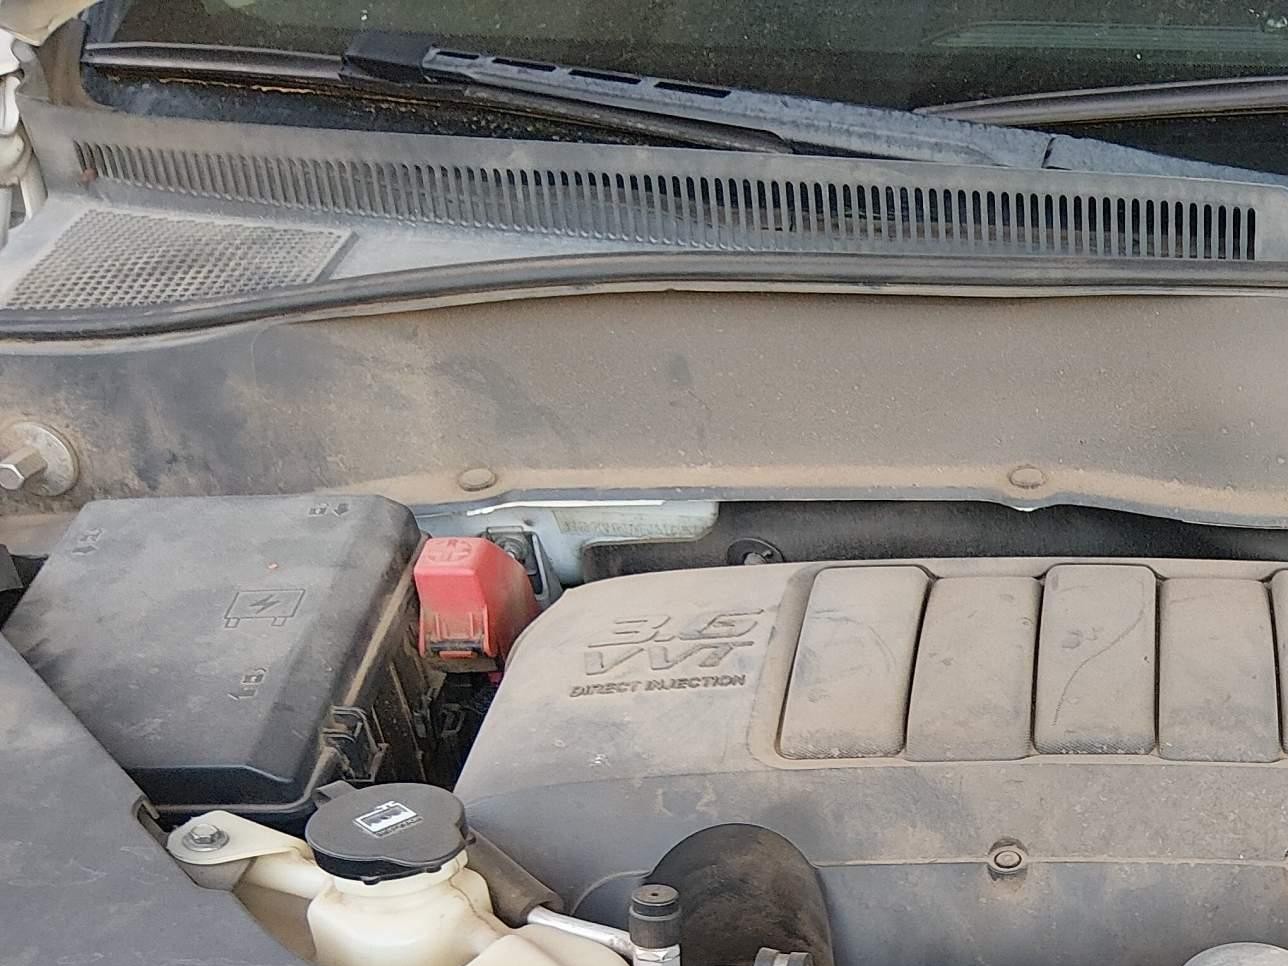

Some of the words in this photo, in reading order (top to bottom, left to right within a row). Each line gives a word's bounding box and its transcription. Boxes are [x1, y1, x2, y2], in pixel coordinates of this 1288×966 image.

[587, 607, 764, 648] 3.6
[583, 640, 754, 676] VVT
[569, 680, 642, 698] DIRECT
[644, 674, 747, 692] INJECTION
